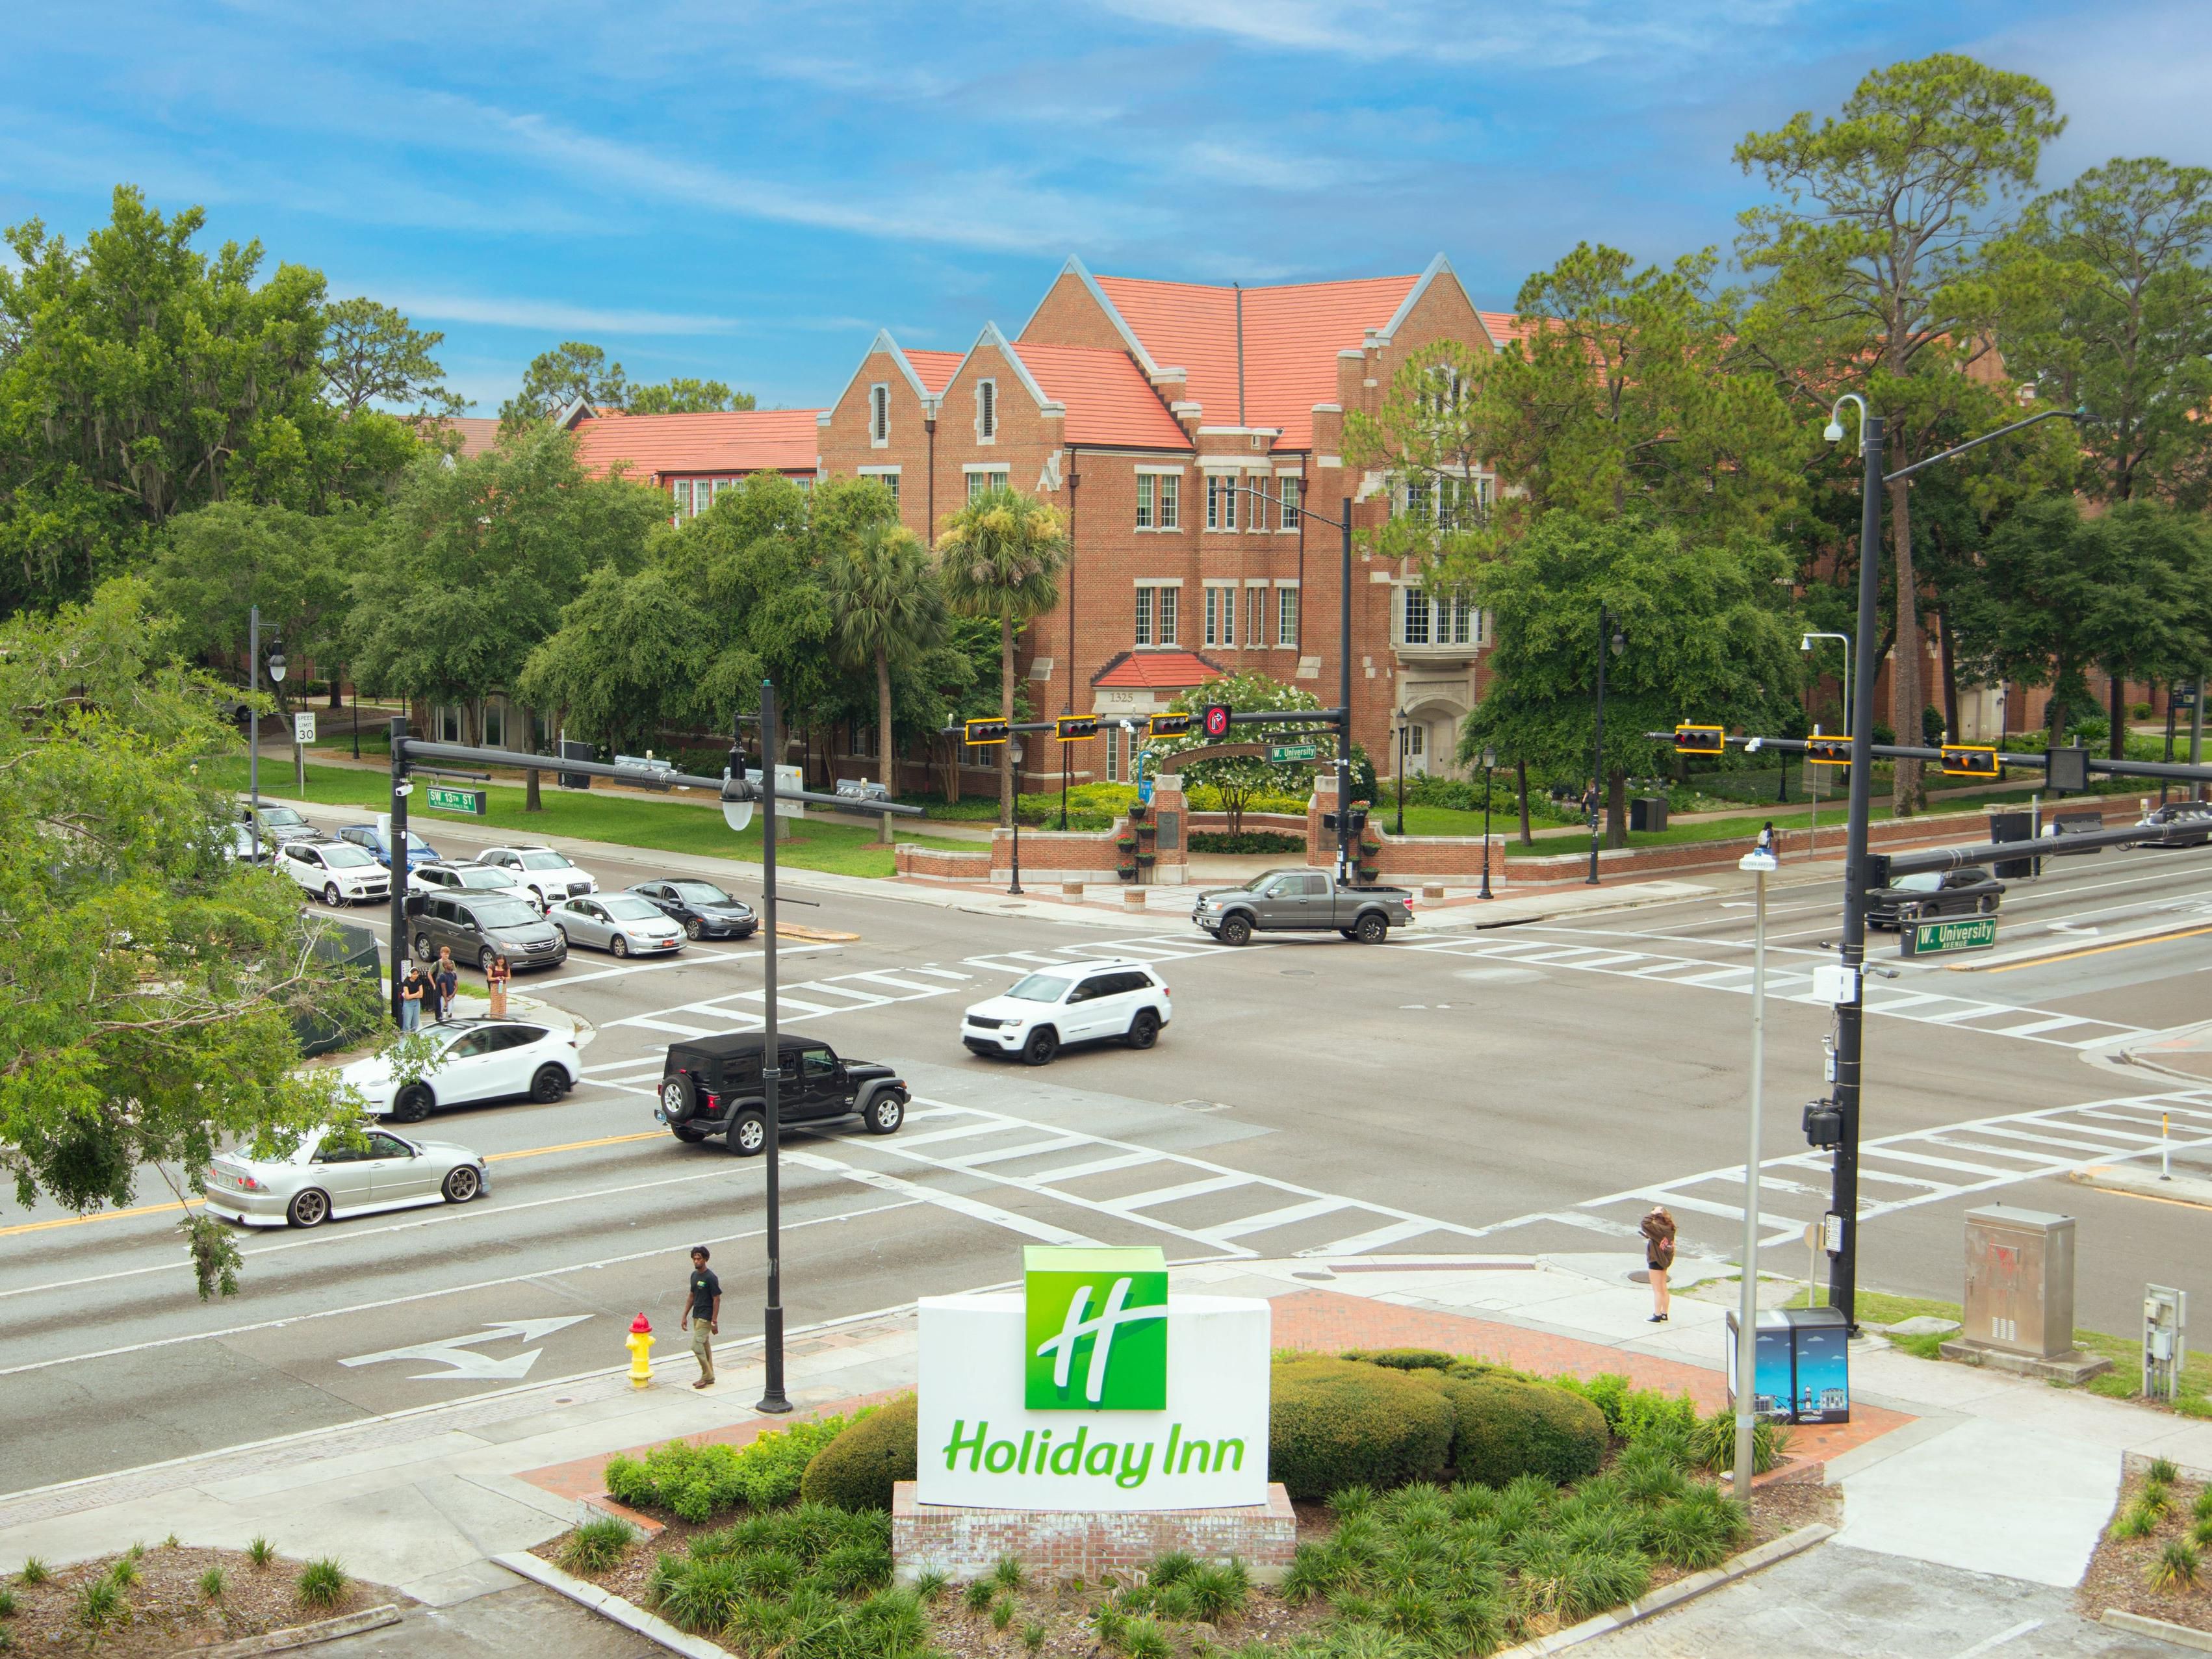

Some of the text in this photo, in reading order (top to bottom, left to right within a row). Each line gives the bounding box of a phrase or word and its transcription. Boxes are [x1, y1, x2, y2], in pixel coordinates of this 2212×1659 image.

[1110, 693, 1133, 702] 1325
[299, 730, 313, 739] 30
[1274, 747, 1315, 758] W. University
[430, 791, 441, 801] SW
[462, 795, 472, 805] ST
[1921, 922, 1993, 944] W. University
[1942, 940, 1968, 949] AVENUE
[942, 1419, 1244, 1489] Holiday Inn
